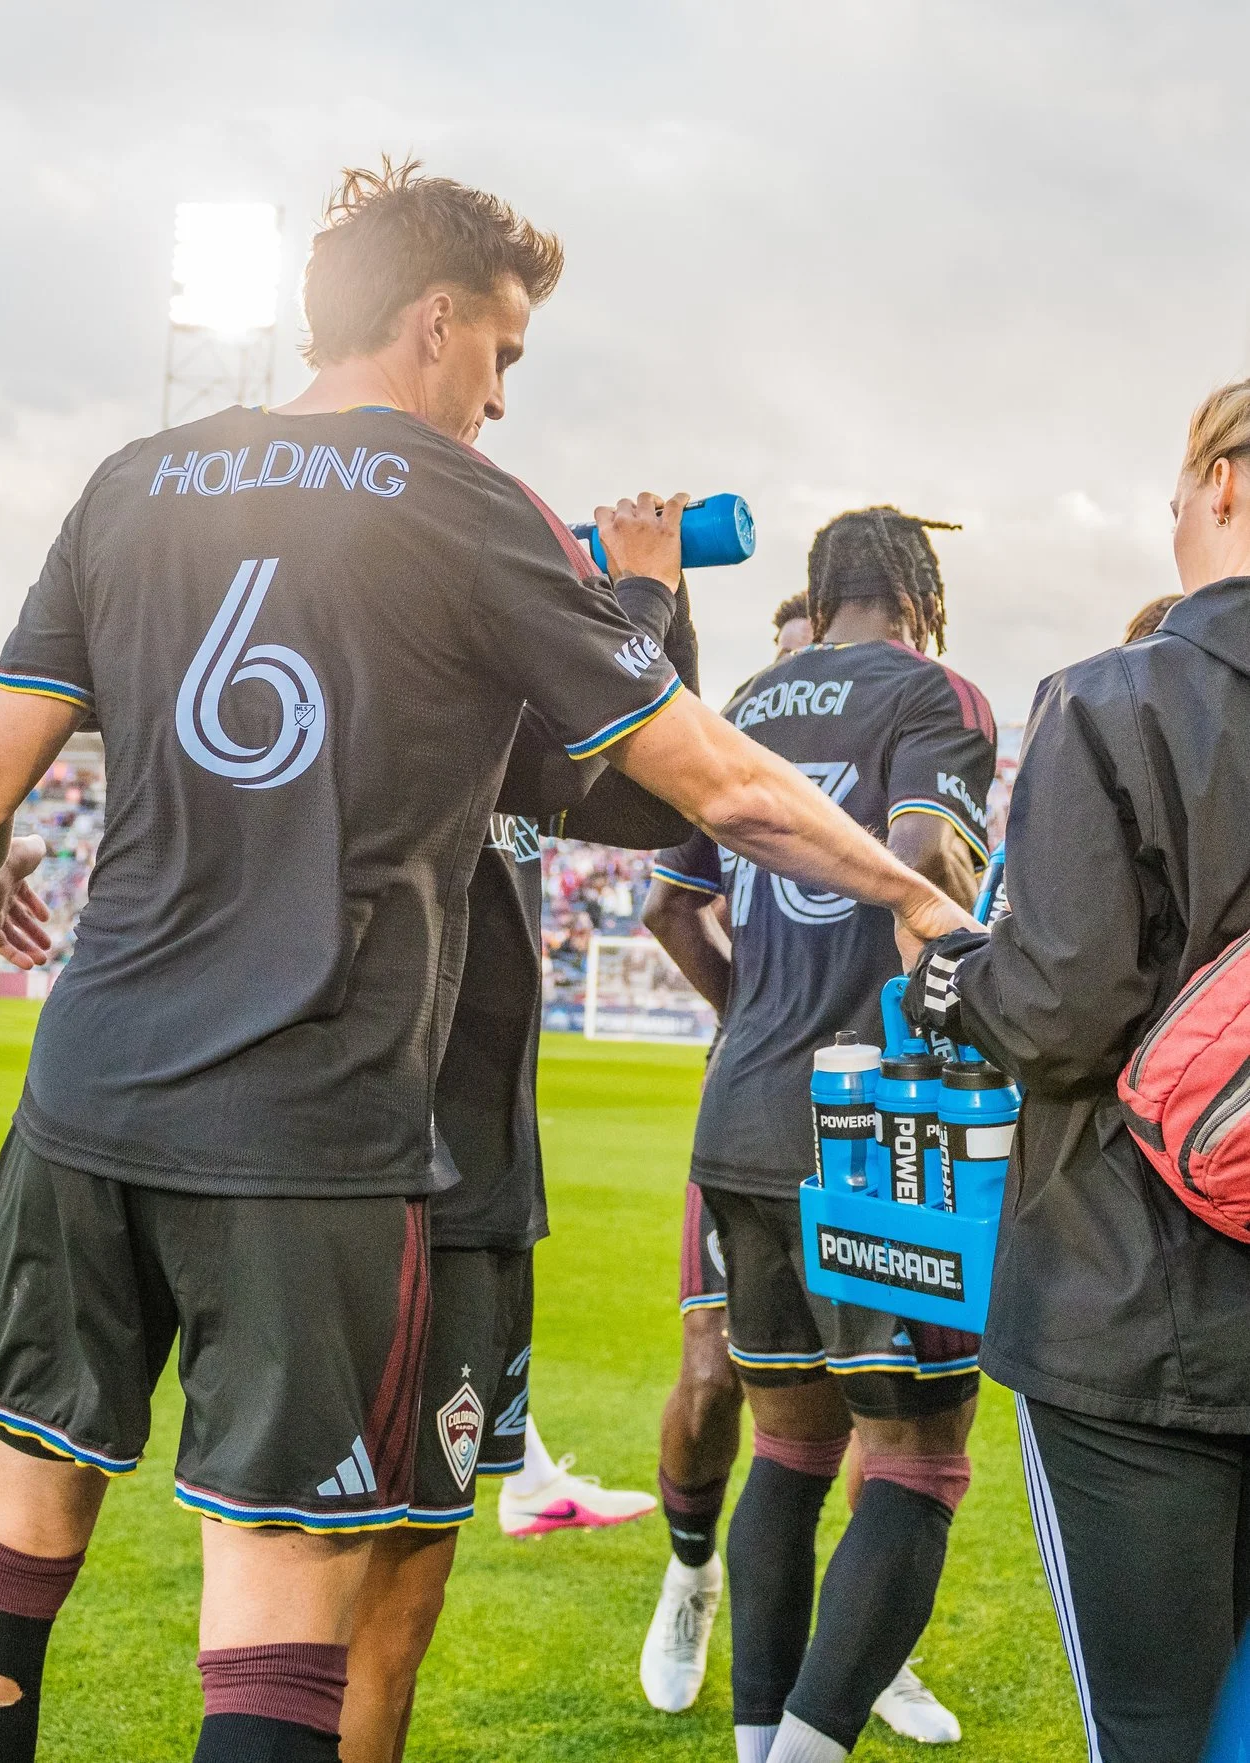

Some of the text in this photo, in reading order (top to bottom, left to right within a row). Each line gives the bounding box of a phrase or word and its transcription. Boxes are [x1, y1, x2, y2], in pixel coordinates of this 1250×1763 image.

[149, 440, 410, 497] HOLDING
[175, 557, 326, 789] 6
[735, 680, 854, 730] GEORGI
